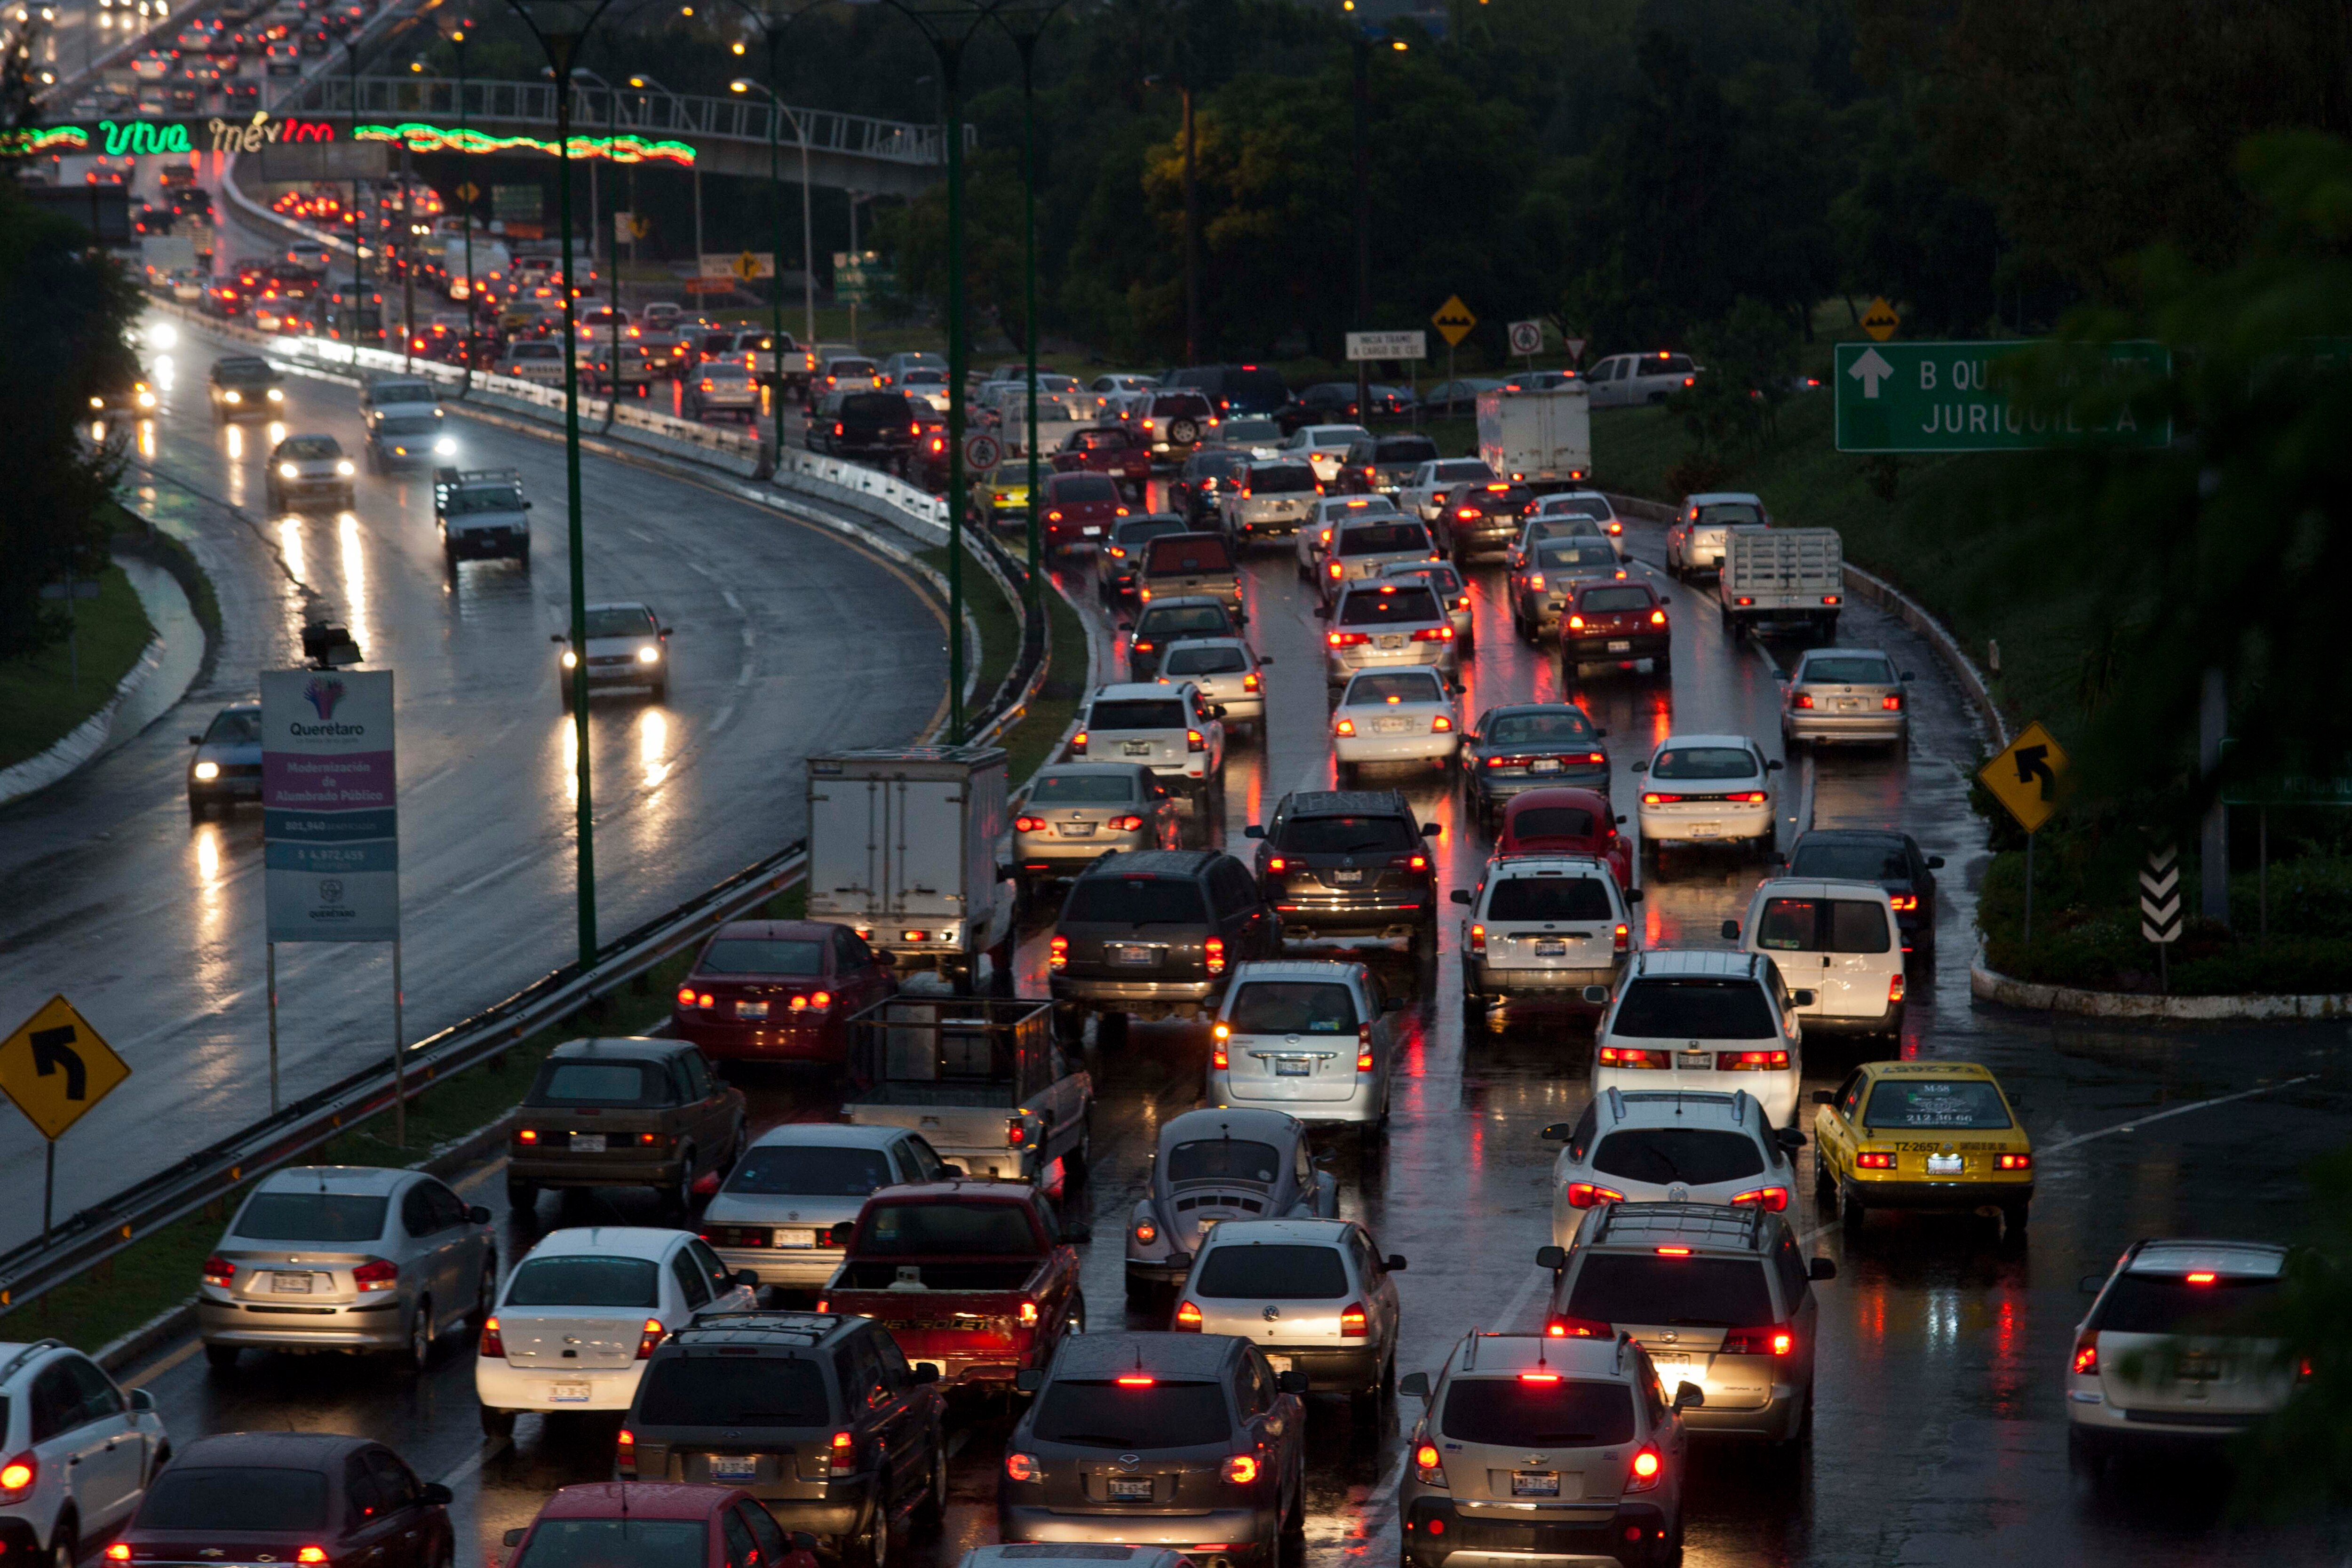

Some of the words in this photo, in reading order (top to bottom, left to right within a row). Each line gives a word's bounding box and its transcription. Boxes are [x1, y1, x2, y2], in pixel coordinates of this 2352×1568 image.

[1921, 360, 1937, 390] B
[1922, 404, 2137, 434] JURIQUILA
[321, 776, 336, 787] de
[276, 791, 338, 801] Alumbrado
[341, 790, 384, 801] Público
[1923, 1084, 1950, 1093] M-58
[1907, 1114, 1929, 1122] 212
[1894, 1142, 1940, 1152] TZ-2657
[881, 1319, 989, 1330] HEVROLET
